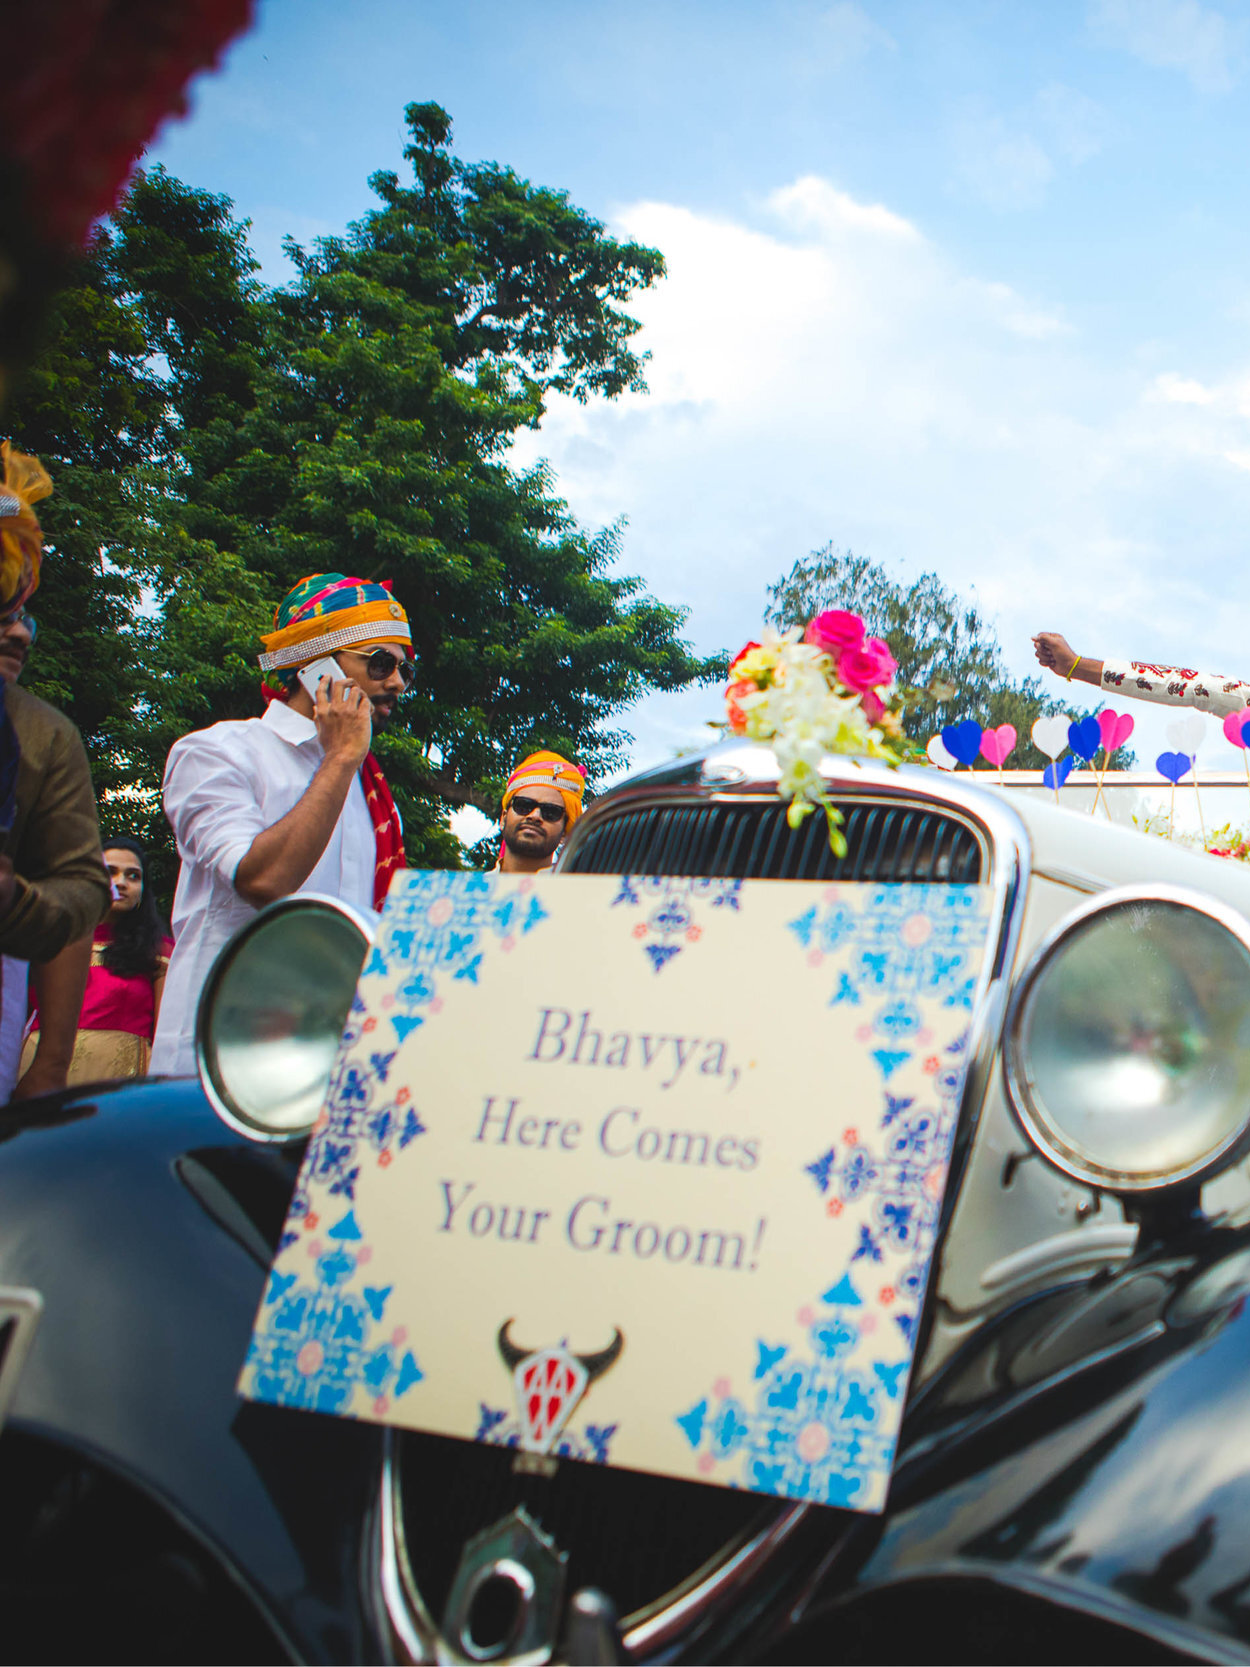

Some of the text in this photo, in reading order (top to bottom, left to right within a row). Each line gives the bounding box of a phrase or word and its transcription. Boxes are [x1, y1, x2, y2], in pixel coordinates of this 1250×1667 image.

[526, 1006, 741, 1092] Bhavya,
[474, 1096, 760, 1171] Here Comes
[438, 1180, 768, 1271] Your Groom!
